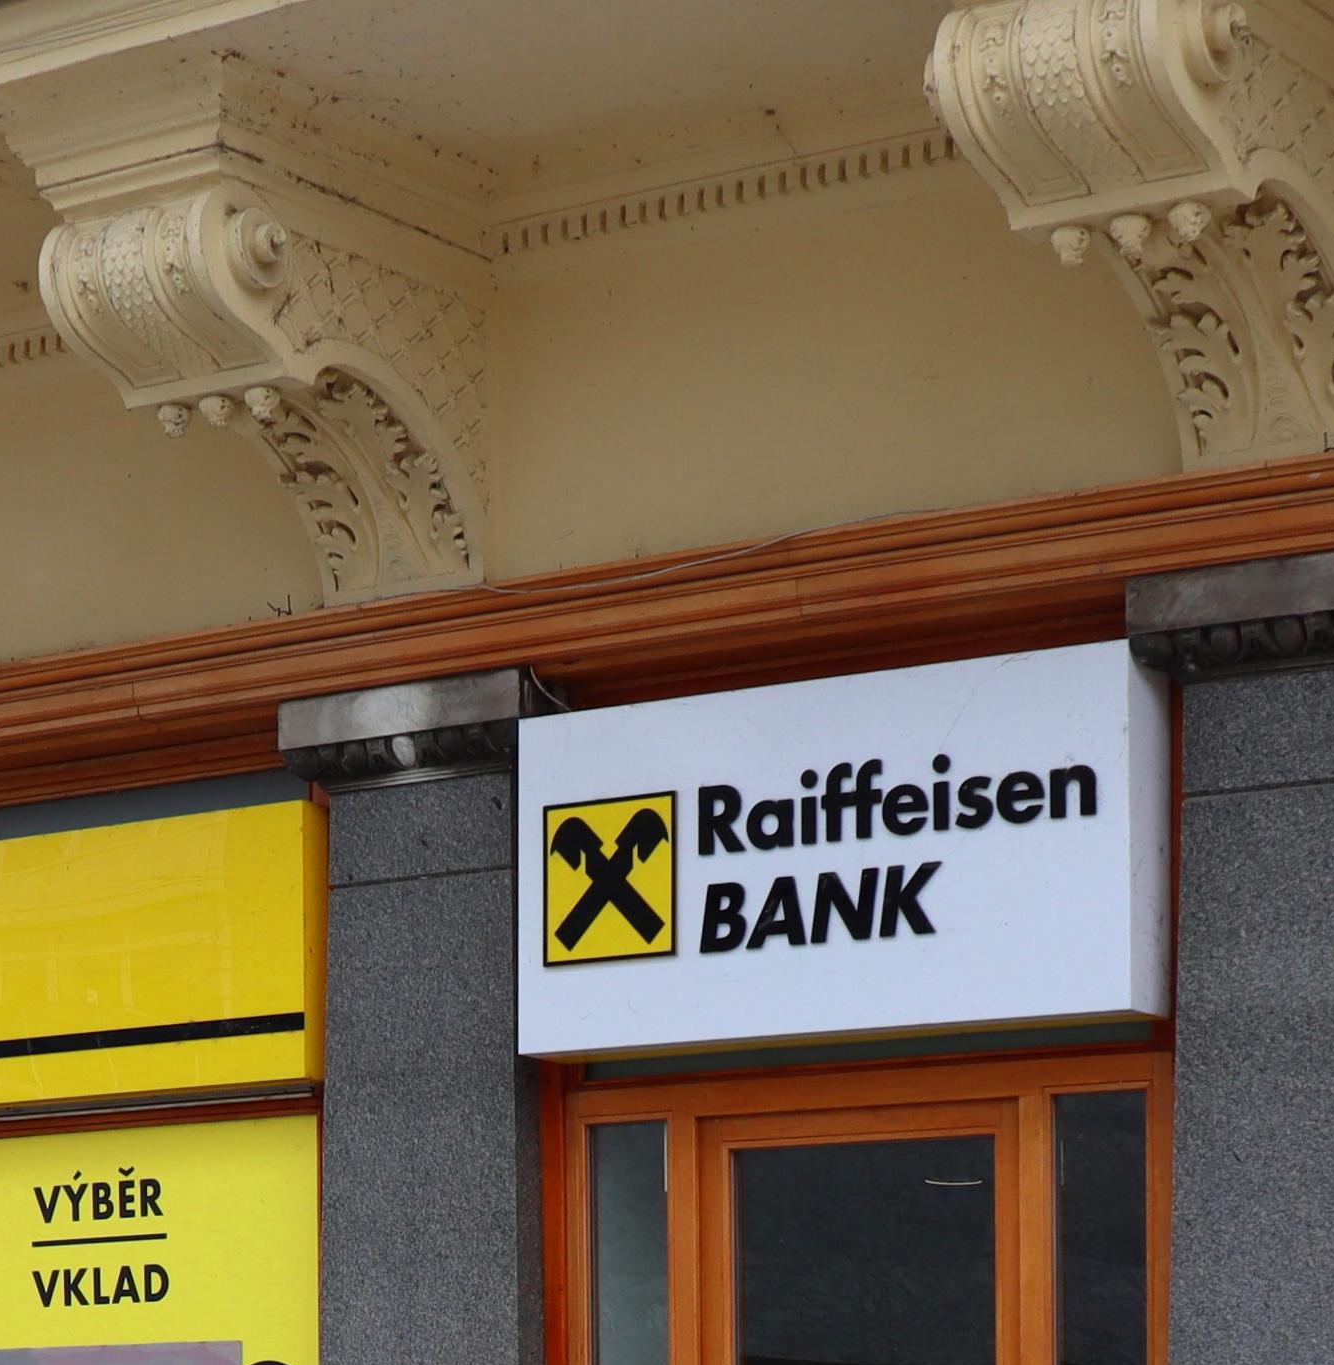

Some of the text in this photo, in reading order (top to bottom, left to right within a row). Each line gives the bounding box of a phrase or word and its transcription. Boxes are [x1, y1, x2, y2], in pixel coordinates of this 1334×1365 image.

[697, 753, 1098, 857] Raiffeisen
[698, 860, 943, 954] BANK
[32, 1165, 164, 1224] VÝBĚR
[31, 1263, 170, 1308] VKLAD
